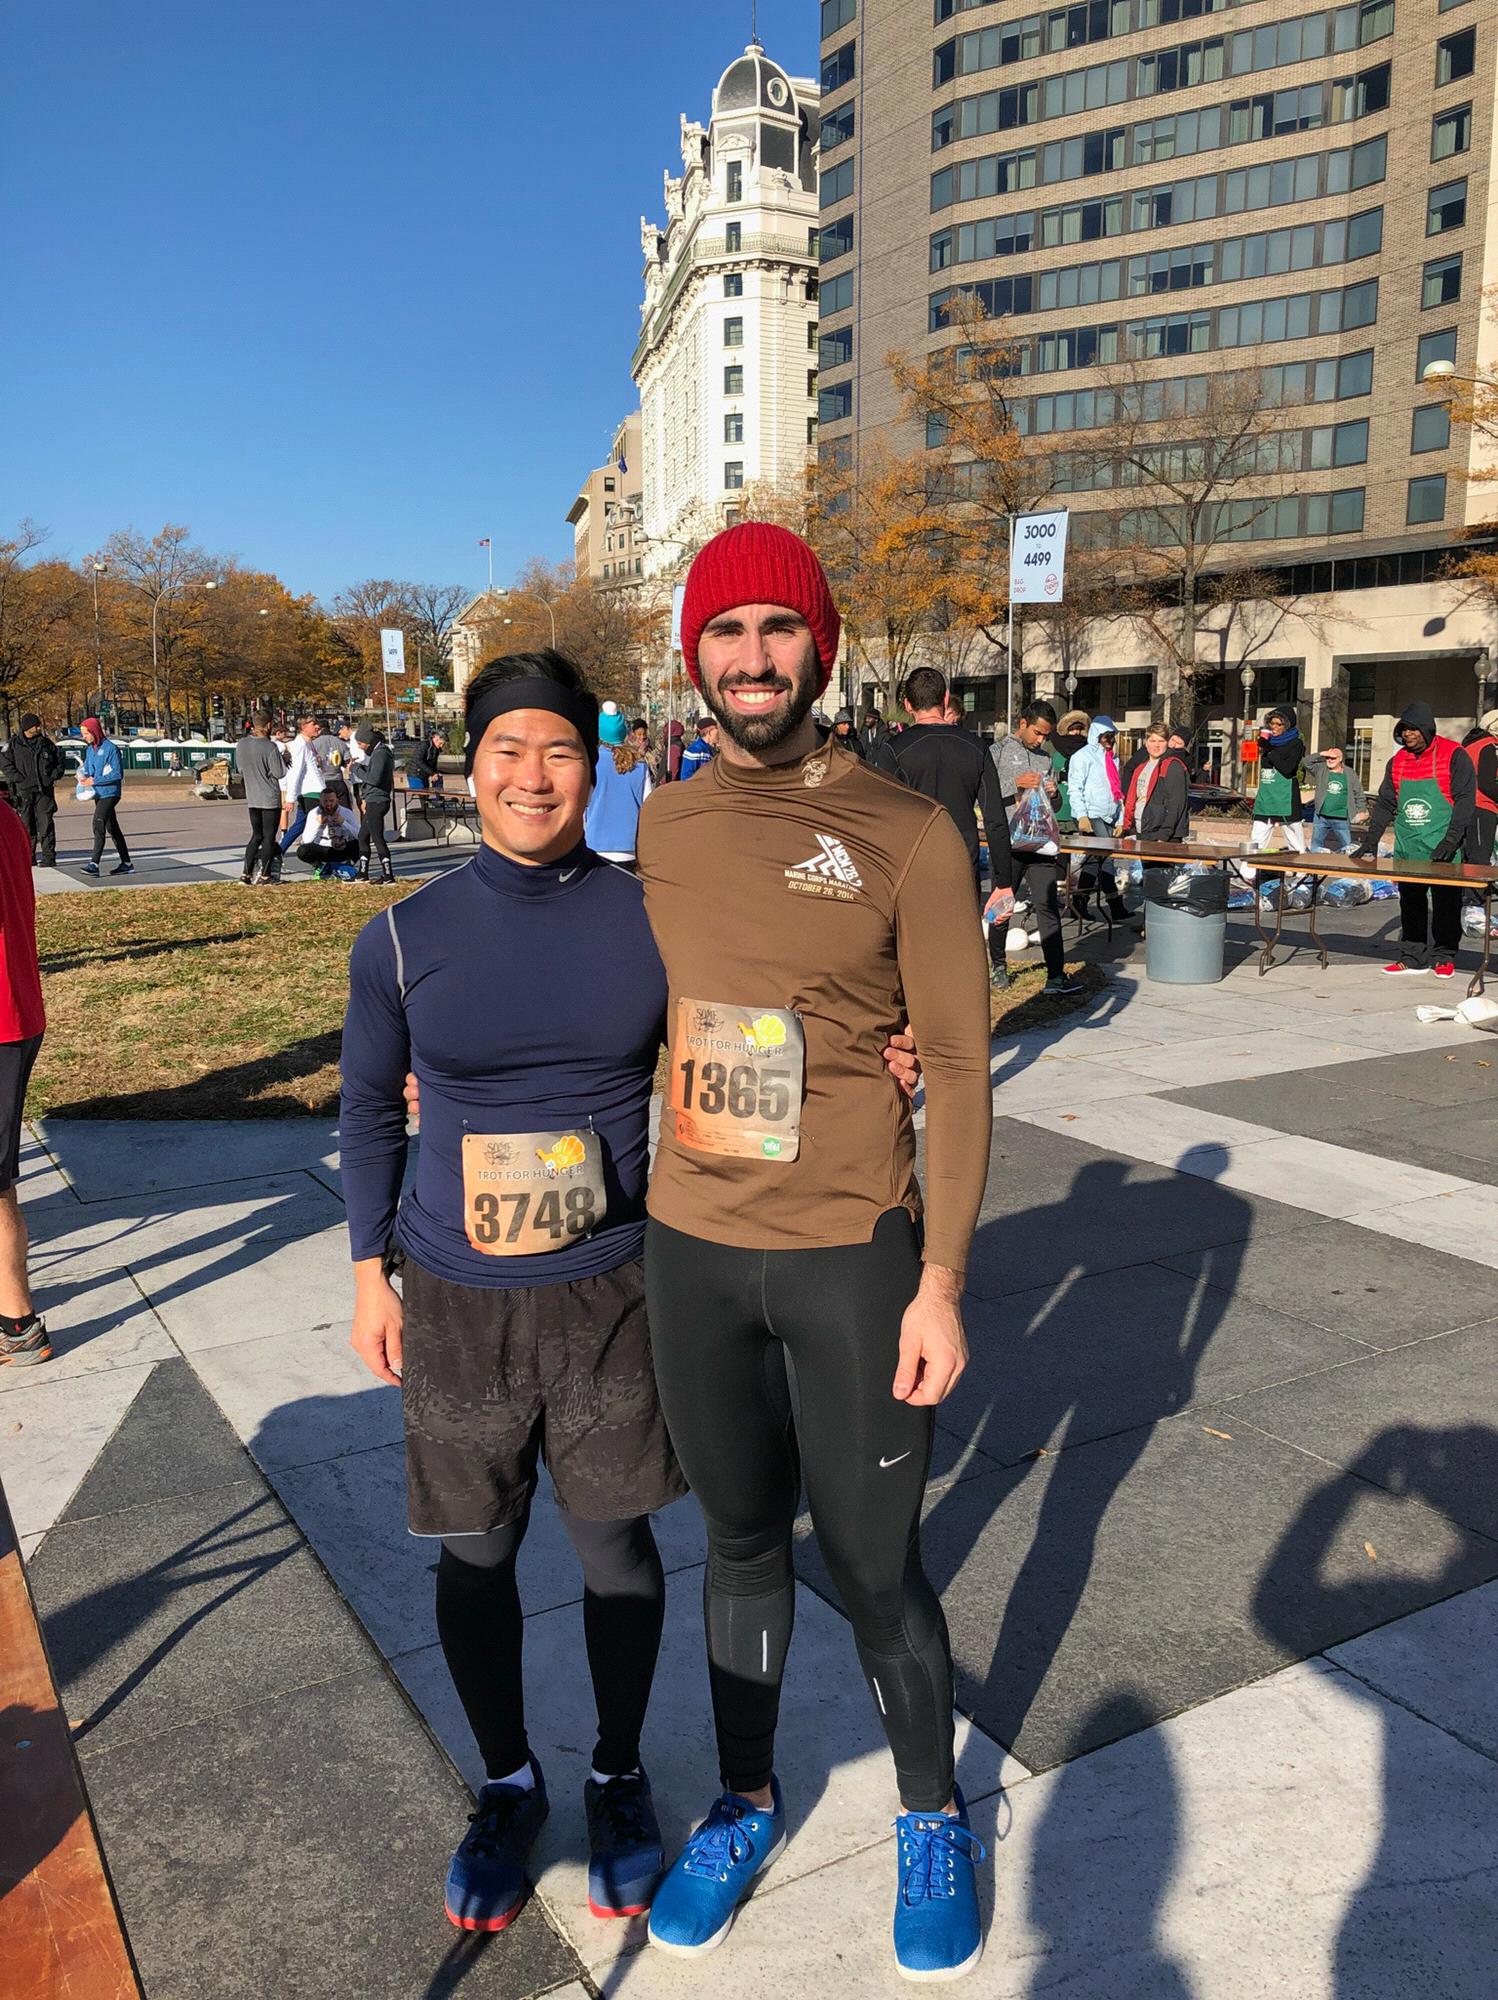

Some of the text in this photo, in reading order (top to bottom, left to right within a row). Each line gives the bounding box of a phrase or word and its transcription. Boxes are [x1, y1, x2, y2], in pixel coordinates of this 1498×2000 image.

[1024, 523, 1056, 539] 3000
[1024, 552, 1051, 566] 4499
[832, 845, 853, 868] MCM
[784, 870, 806, 880] MARINE
[807, 874, 827, 884] CORPS
[788, 881, 822, 894] OCTOBER
[836, 889, 855, 901] 2014
[696, 1007, 718, 1020] SOME
[711, 1039, 732, 1050] FOR
[734, 1043, 783, 1056] HUNGER
[680, 1059, 792, 1122] 1365
[487, 1142, 514, 1154] SOME
[477, 1165, 584, 1180] TROT FOR HUNGER
[474, 1186, 596, 1244] 3748
